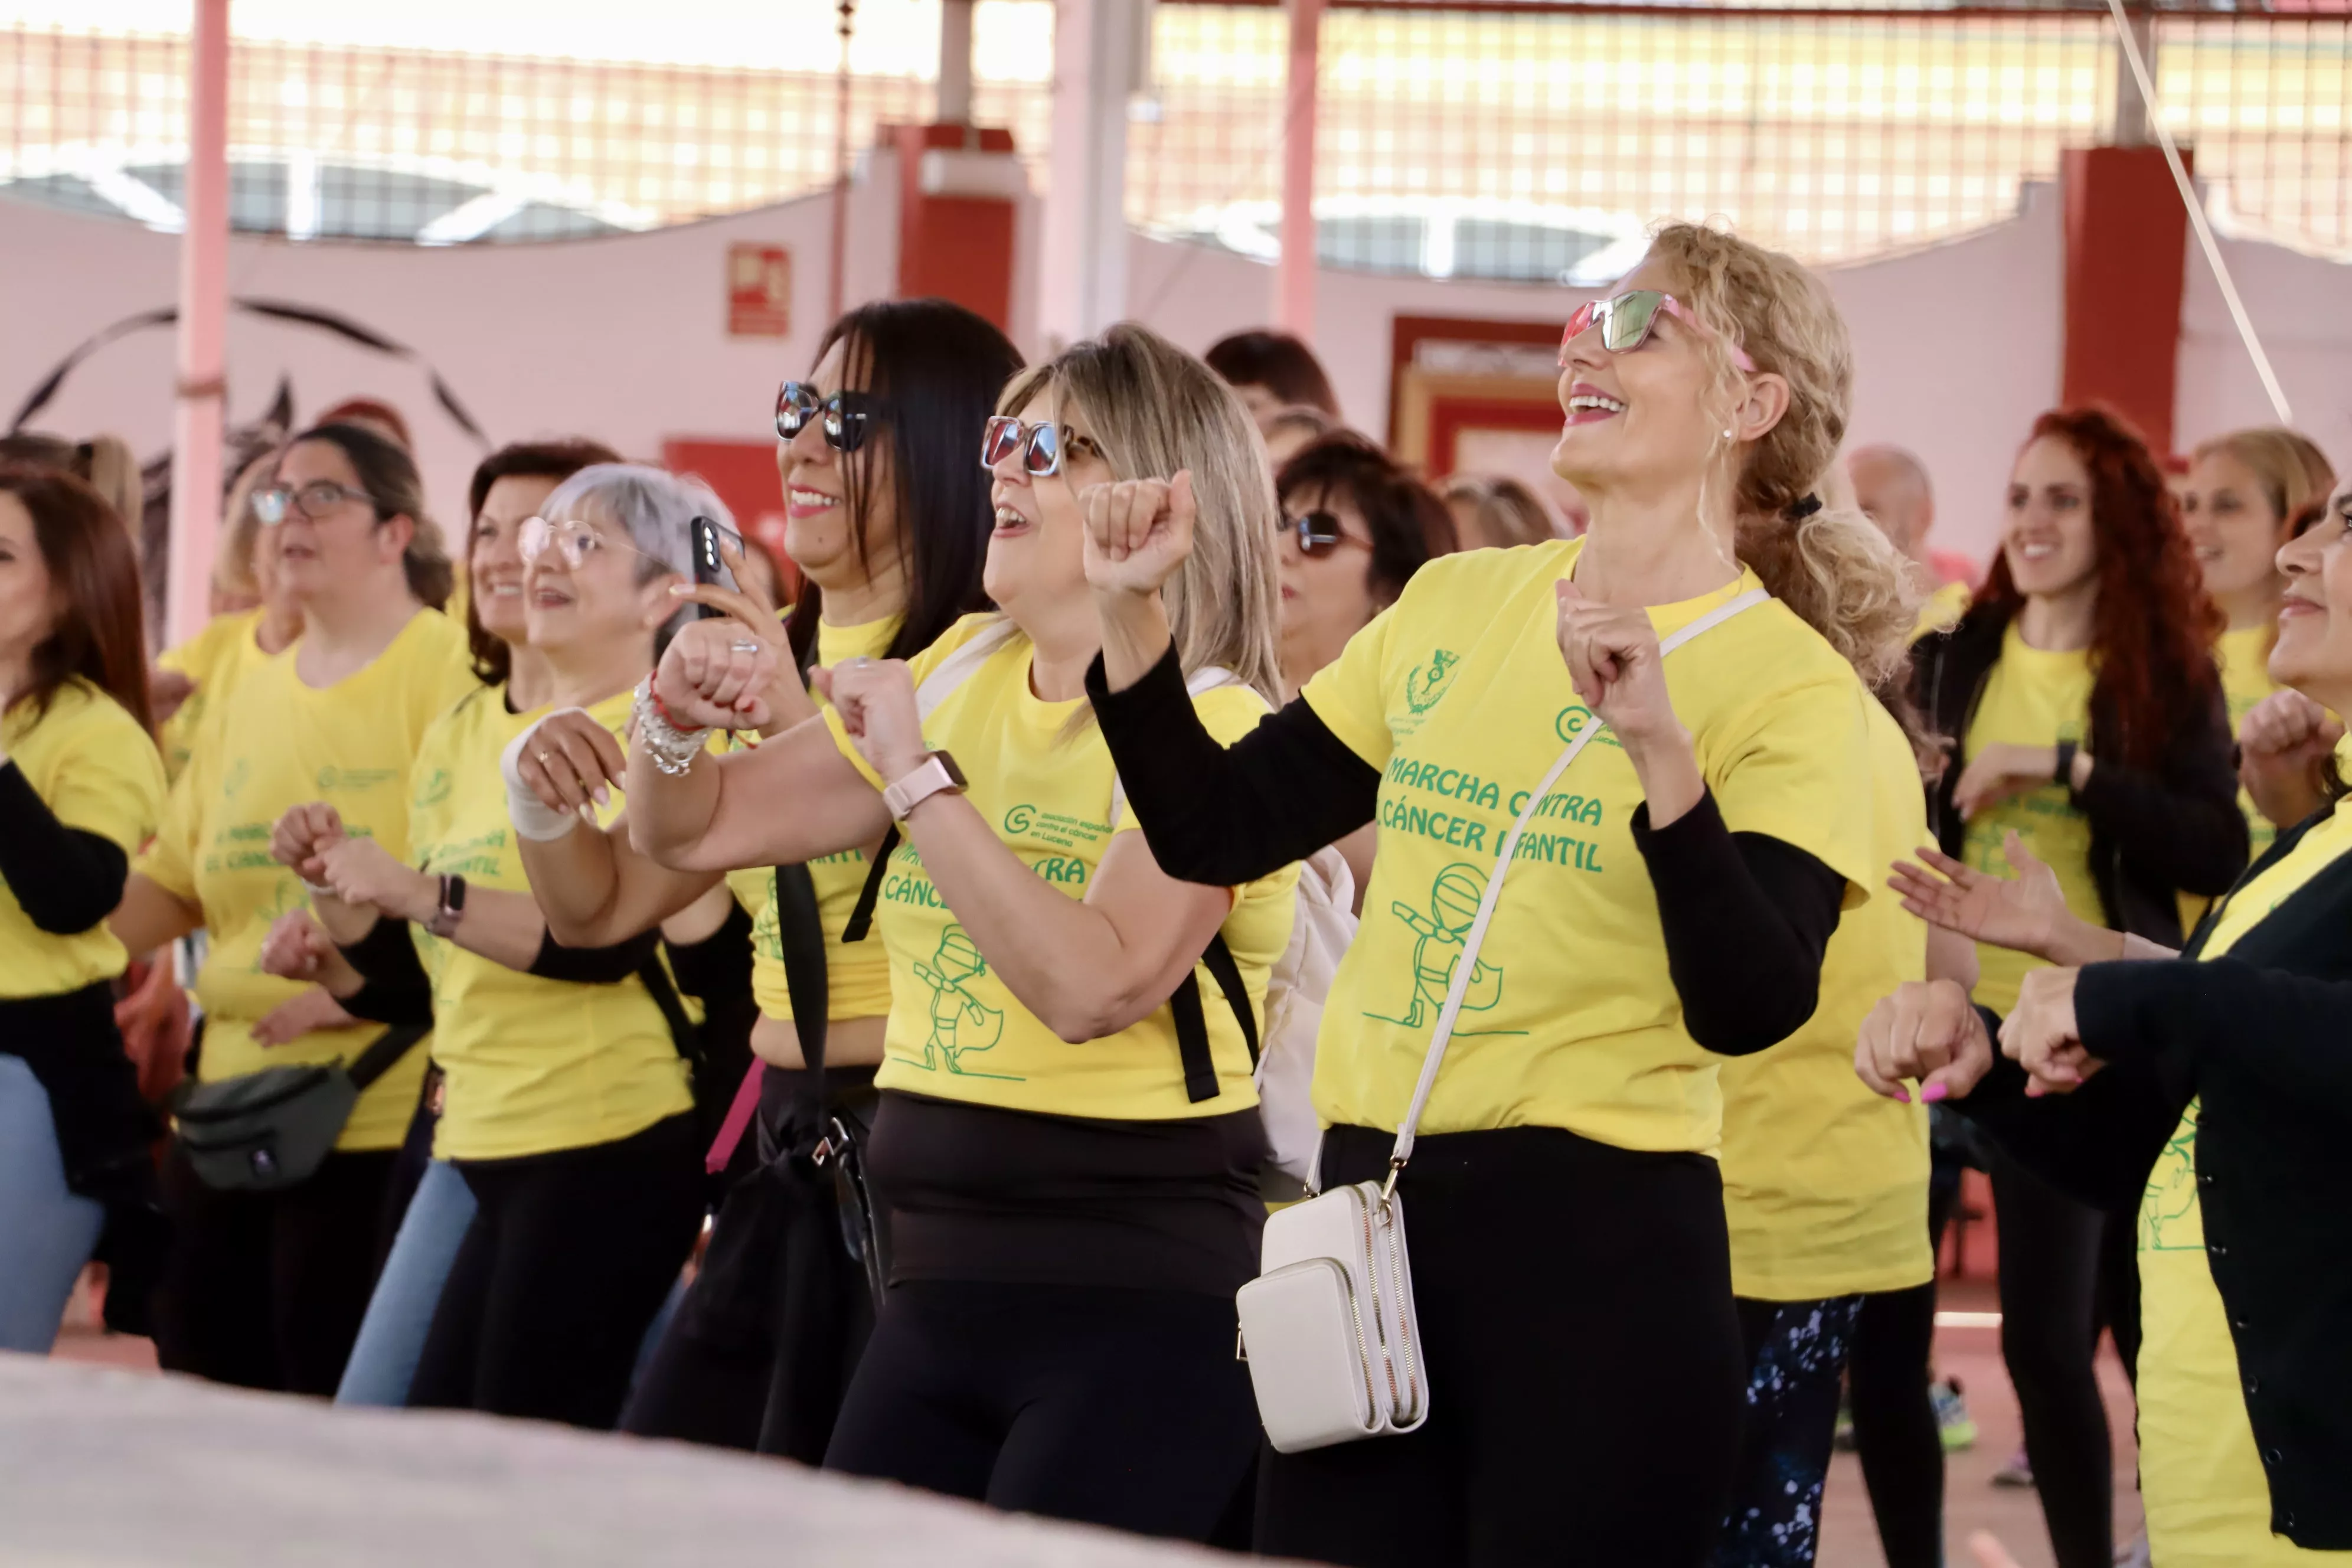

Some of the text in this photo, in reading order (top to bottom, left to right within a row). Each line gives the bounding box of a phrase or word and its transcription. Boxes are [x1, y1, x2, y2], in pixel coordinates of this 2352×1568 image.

[1386, 757, 1602, 827] MARCHA CNTRA
[1042, 832, 1073, 847] Lucena
[1069, 828, 1098, 841] cáncer
[1383, 795, 1487, 852] CÁNCER
[1494, 830, 1603, 873] IFANTIL
[886, 871, 949, 909] CÁNC
